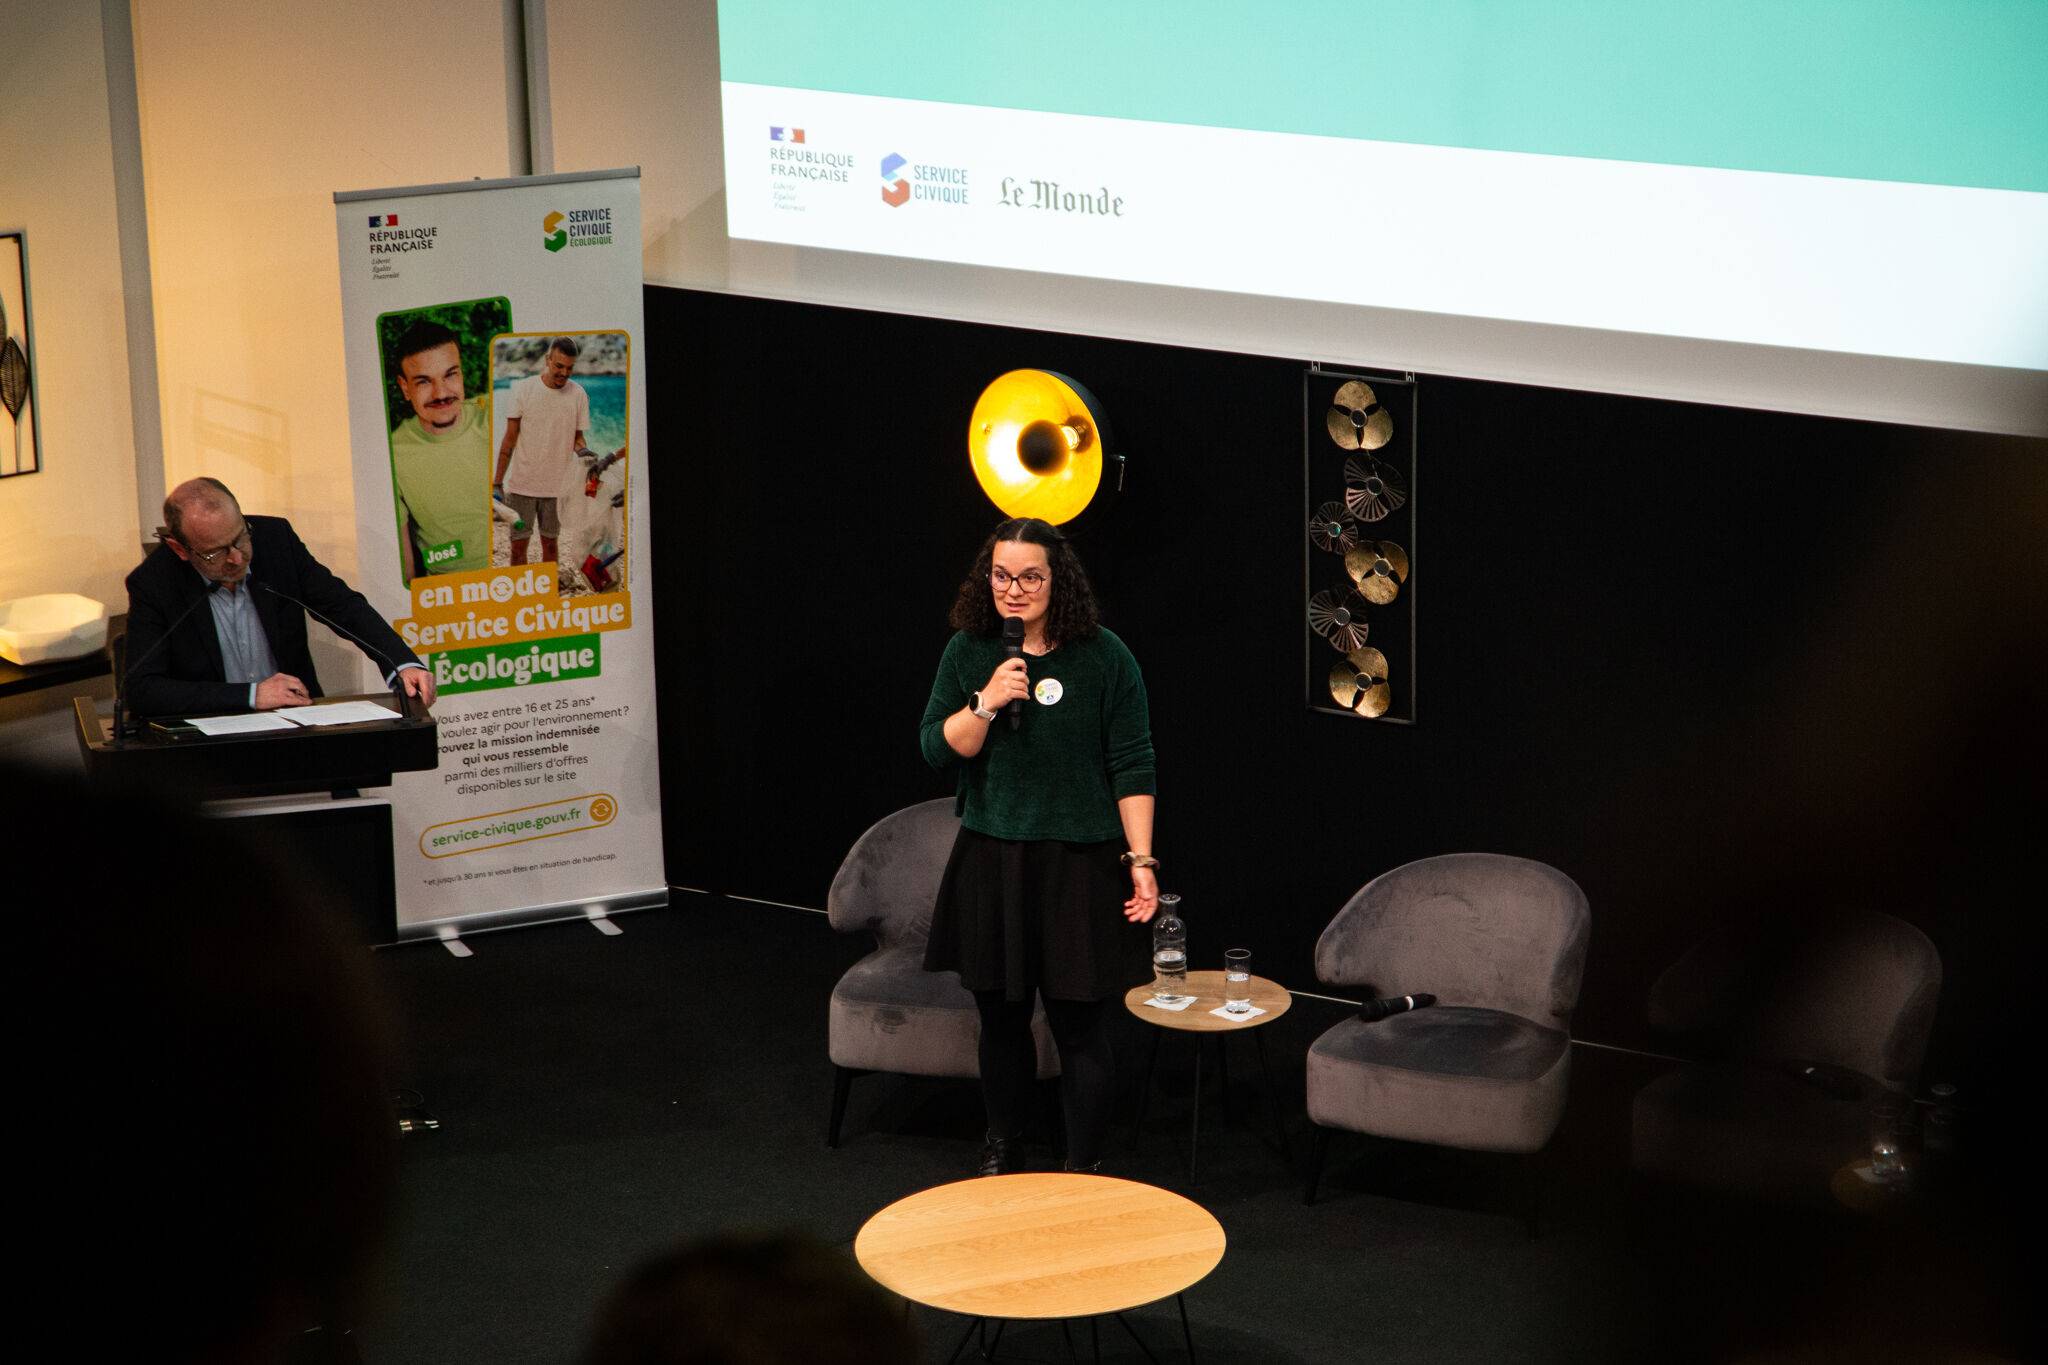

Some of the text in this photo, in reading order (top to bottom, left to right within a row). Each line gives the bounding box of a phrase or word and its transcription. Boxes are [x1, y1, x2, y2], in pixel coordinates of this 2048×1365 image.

[770, 145, 854, 168] RÉPUBLIQUE
[771, 163, 849, 182] FRANÇAISE
[914, 164, 968, 185] SERVICE
[914, 184, 968, 205] CIVIQUE
[998, 176, 1124, 217] Le Monde
[569, 208, 611, 223] SERVICE
[369, 227, 438, 242] RÉPUBLIQUE
[569, 222, 612, 237] CIVIQUE
[370, 240, 434, 254] FRANÇAISE
[570, 236, 613, 247] ÉCOLOGIQUE
[426, 544, 457, 564] José
[418, 586, 454, 609] en
[401, 600, 625, 647] Service Civique
[434, 645, 595, 686] Écologique
[433, 713, 461, 725] Vous
[463, 711, 489, 722] avez
[492, 706, 522, 718] entre
[525, 702, 537, 713] 16
[540, 702, 552, 712] et
[555, 699, 569, 709] 25
[438, 724, 600, 754] rouvez la mission indemnisée
[442, 726, 478, 739] voulez
[480, 722, 501, 736] agir
[504, 720, 530, 732] pour
[462, 743, 569, 767] qui vous ressemble
[444, 755, 589, 784] parmi des milliers d'offres
[457, 770, 577, 795] disponibles sur le site
[432, 808, 582, 847] service-civique.gouv.fr
[512, 865, 528, 873] êtes
[540, 859, 571, 870] situation
[572, 857, 582, 865] de
